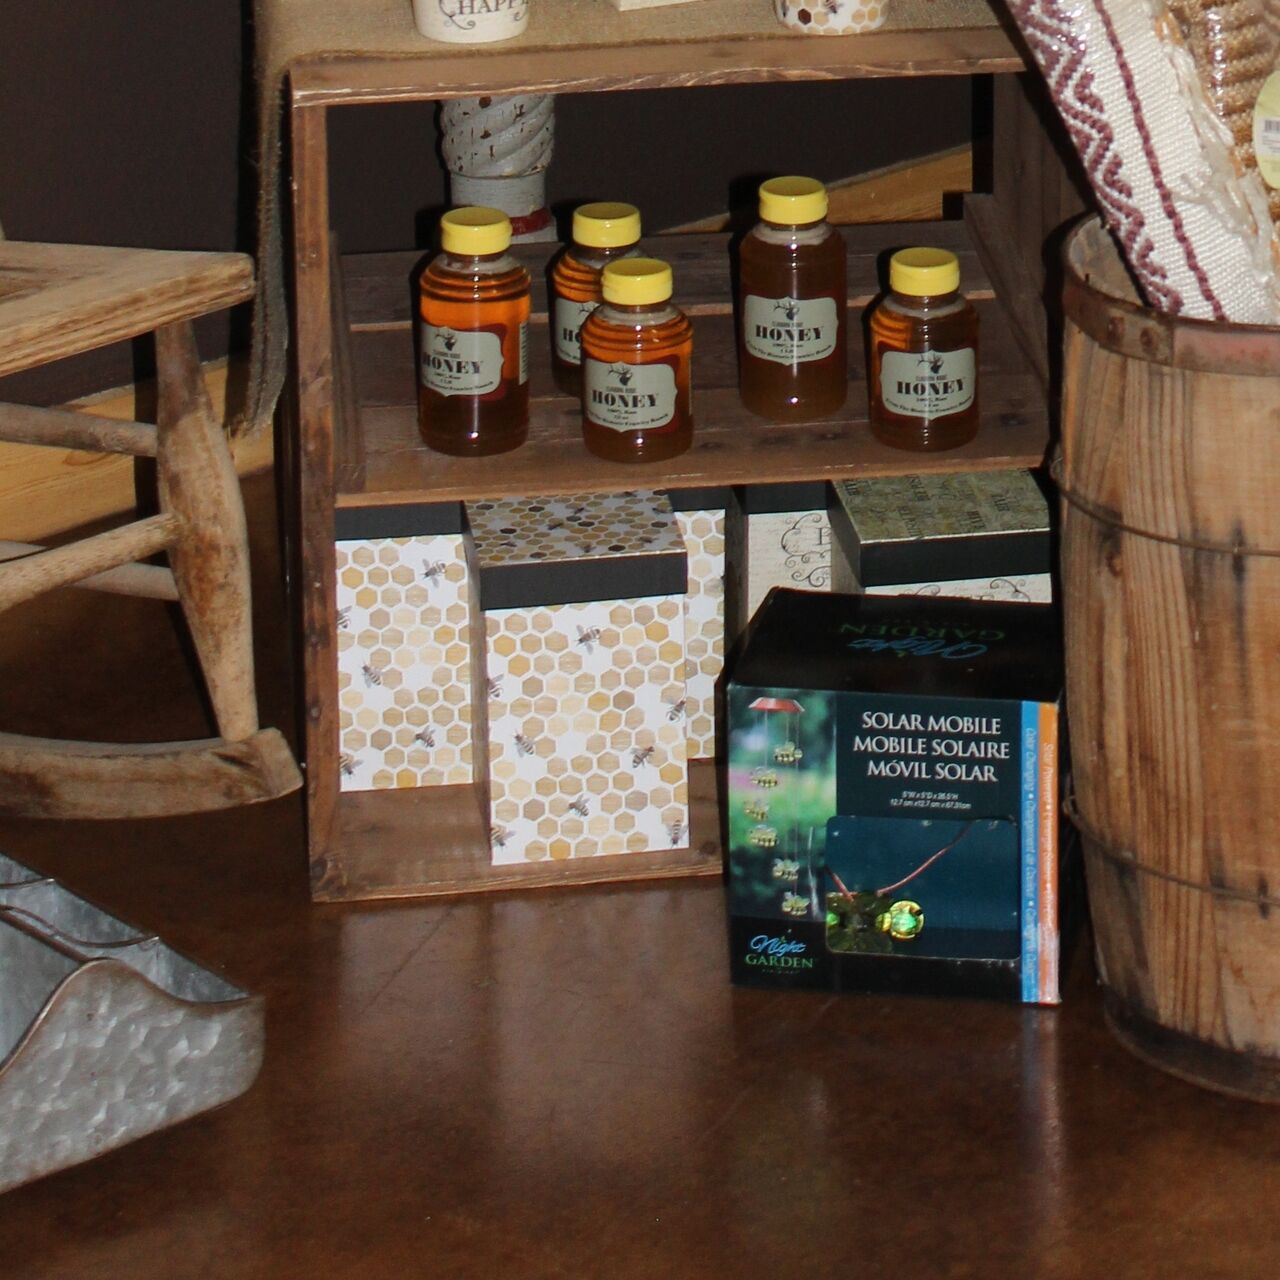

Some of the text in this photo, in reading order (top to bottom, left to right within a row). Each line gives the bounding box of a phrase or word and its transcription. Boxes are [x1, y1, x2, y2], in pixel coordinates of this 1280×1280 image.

[756, 324, 825, 342] HONEY
[897, 378, 976, 396] HONEY
[592, 389, 660, 408] HONEY
[862, 711, 1001, 735] SOLAR MOBILE
[853, 735, 1010, 760] MOBILE SOLAIRE
[867, 758, 999, 783] MÓVIL SOLAR
[751, 935, 807, 957] Night
[745, 953, 814, 969] GARDEN
